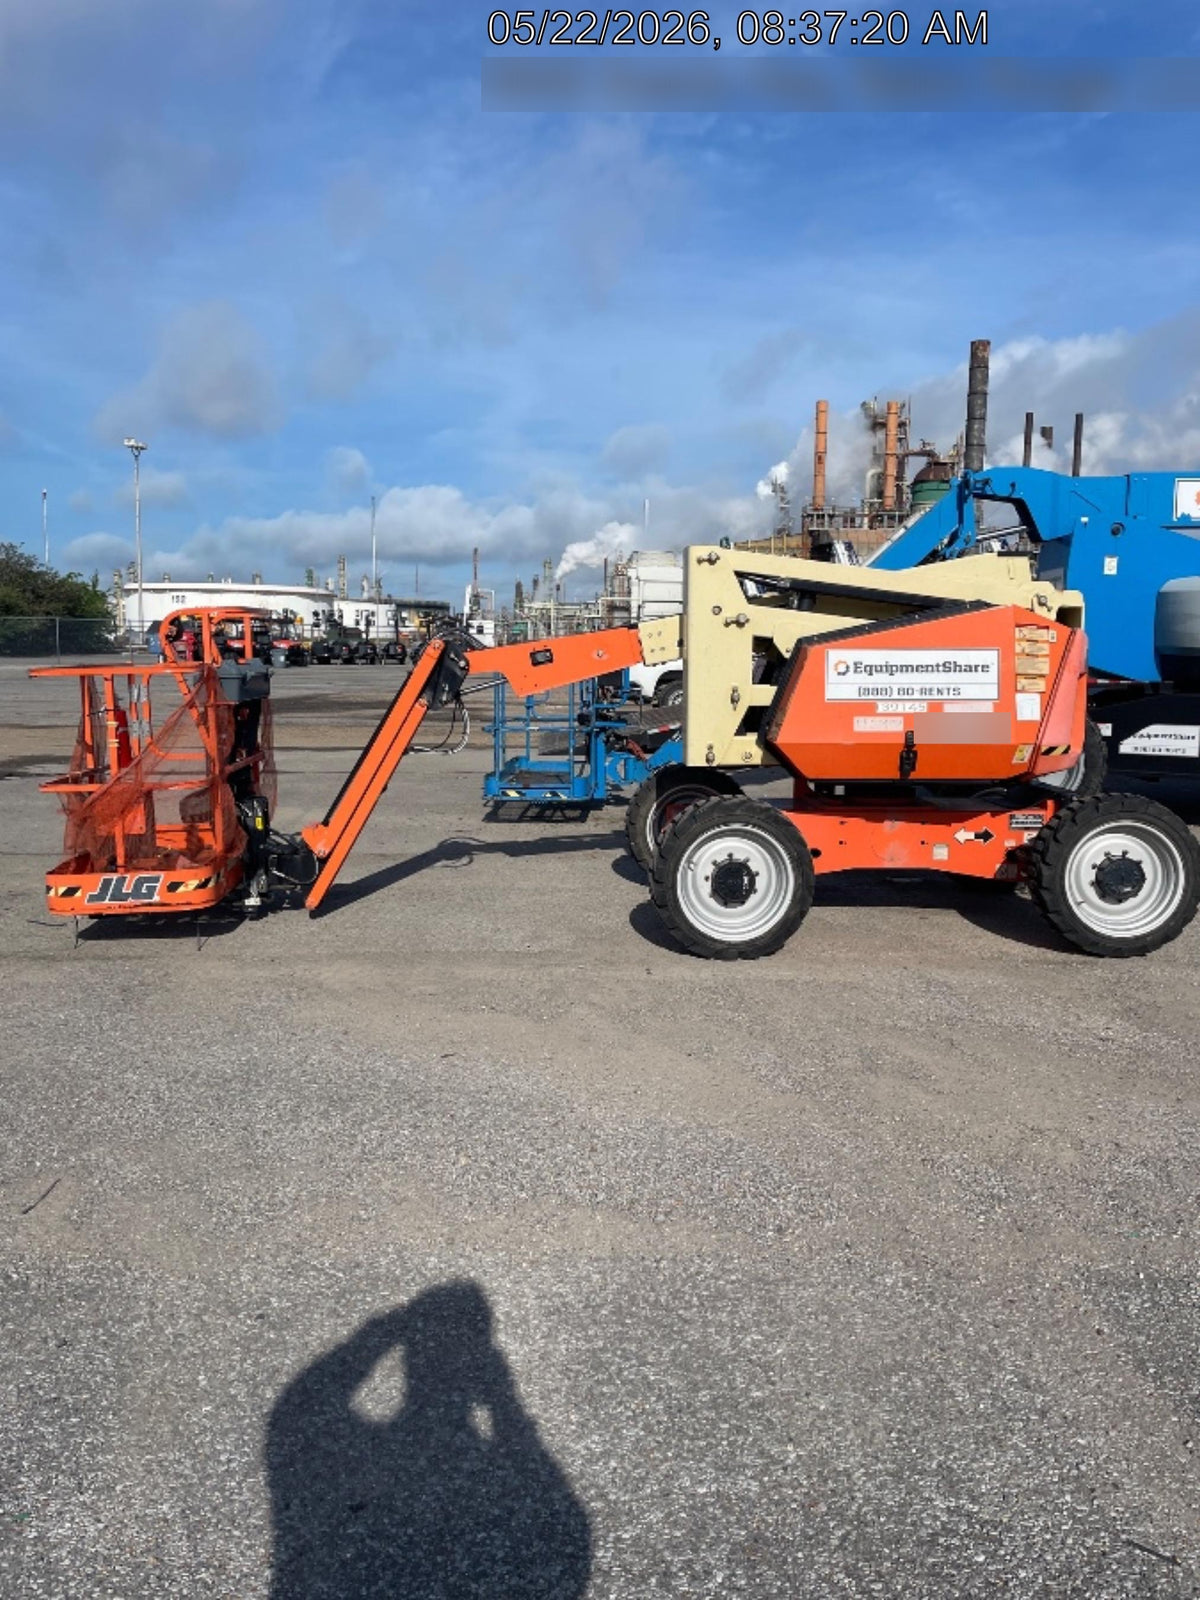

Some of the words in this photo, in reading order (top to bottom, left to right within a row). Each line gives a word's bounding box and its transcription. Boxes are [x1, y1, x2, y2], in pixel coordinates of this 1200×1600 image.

[853, 661, 990, 676] EquipmentShare
[858, 686, 893, 697] (888)
[85, 873, 163, 904] JLG
